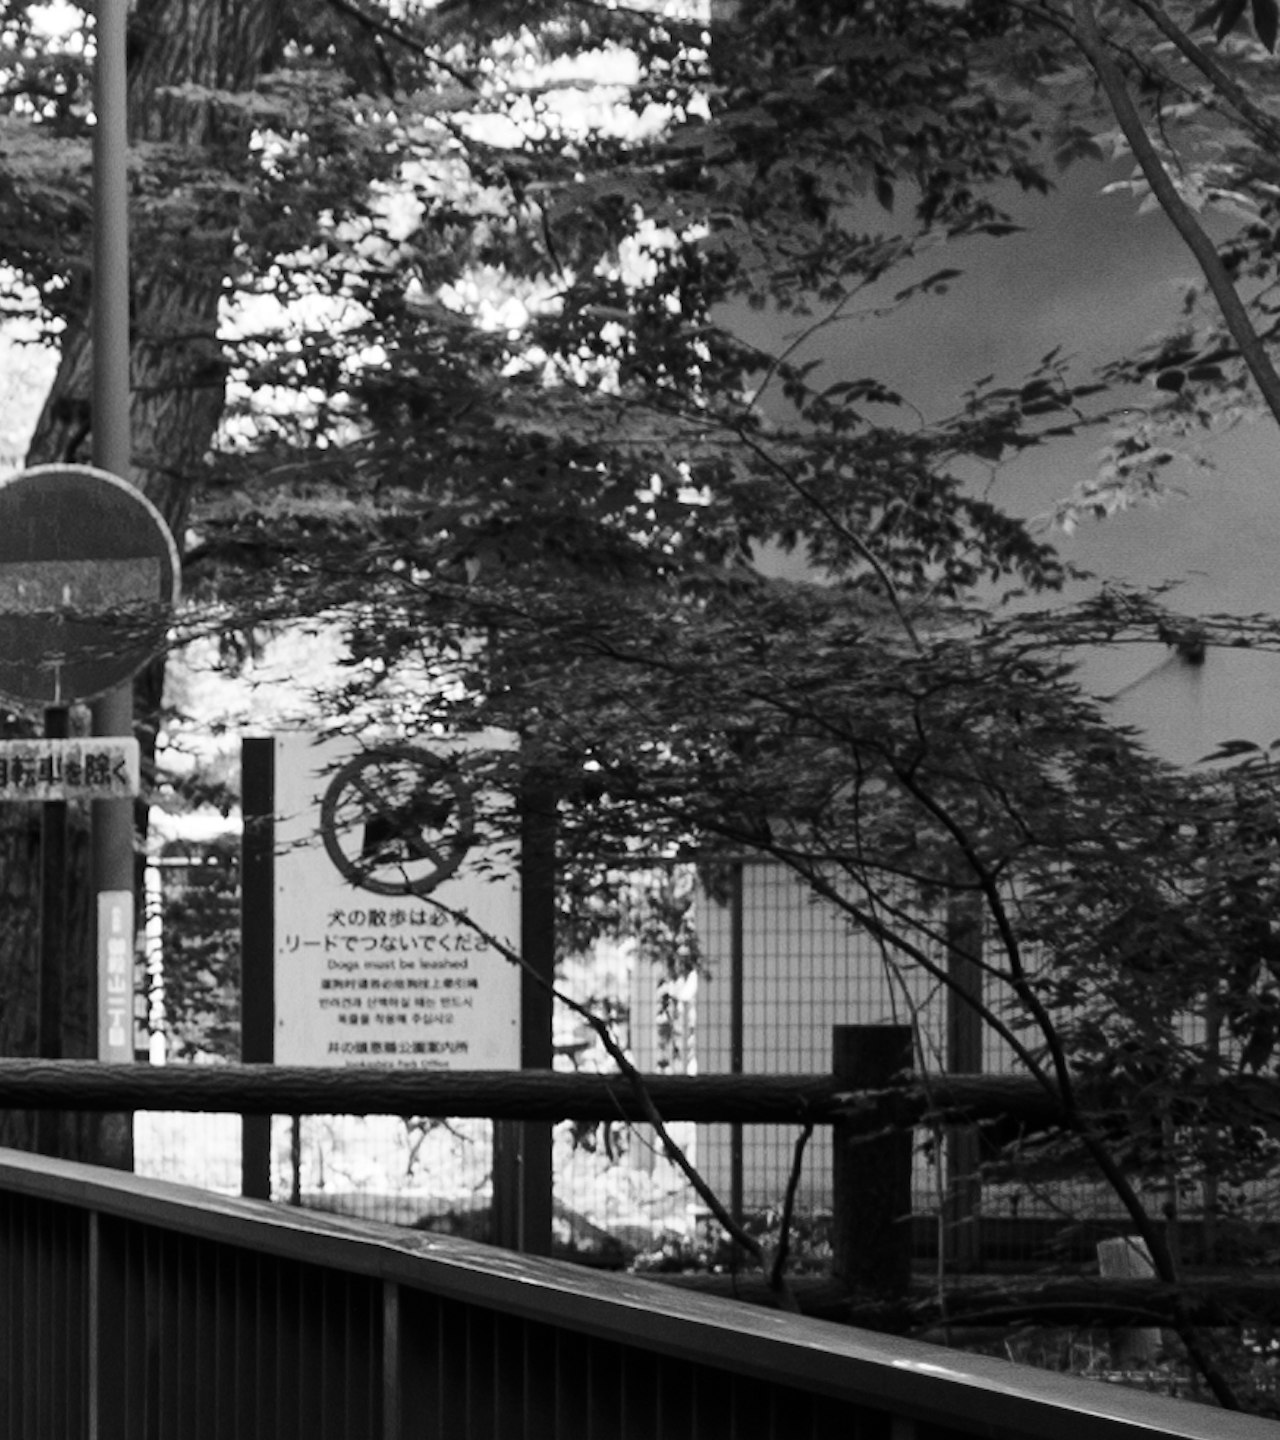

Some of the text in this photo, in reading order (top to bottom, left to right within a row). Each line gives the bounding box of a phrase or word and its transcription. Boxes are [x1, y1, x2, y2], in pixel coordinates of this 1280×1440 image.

[327, 957, 469, 971] Dogs must be leashed
